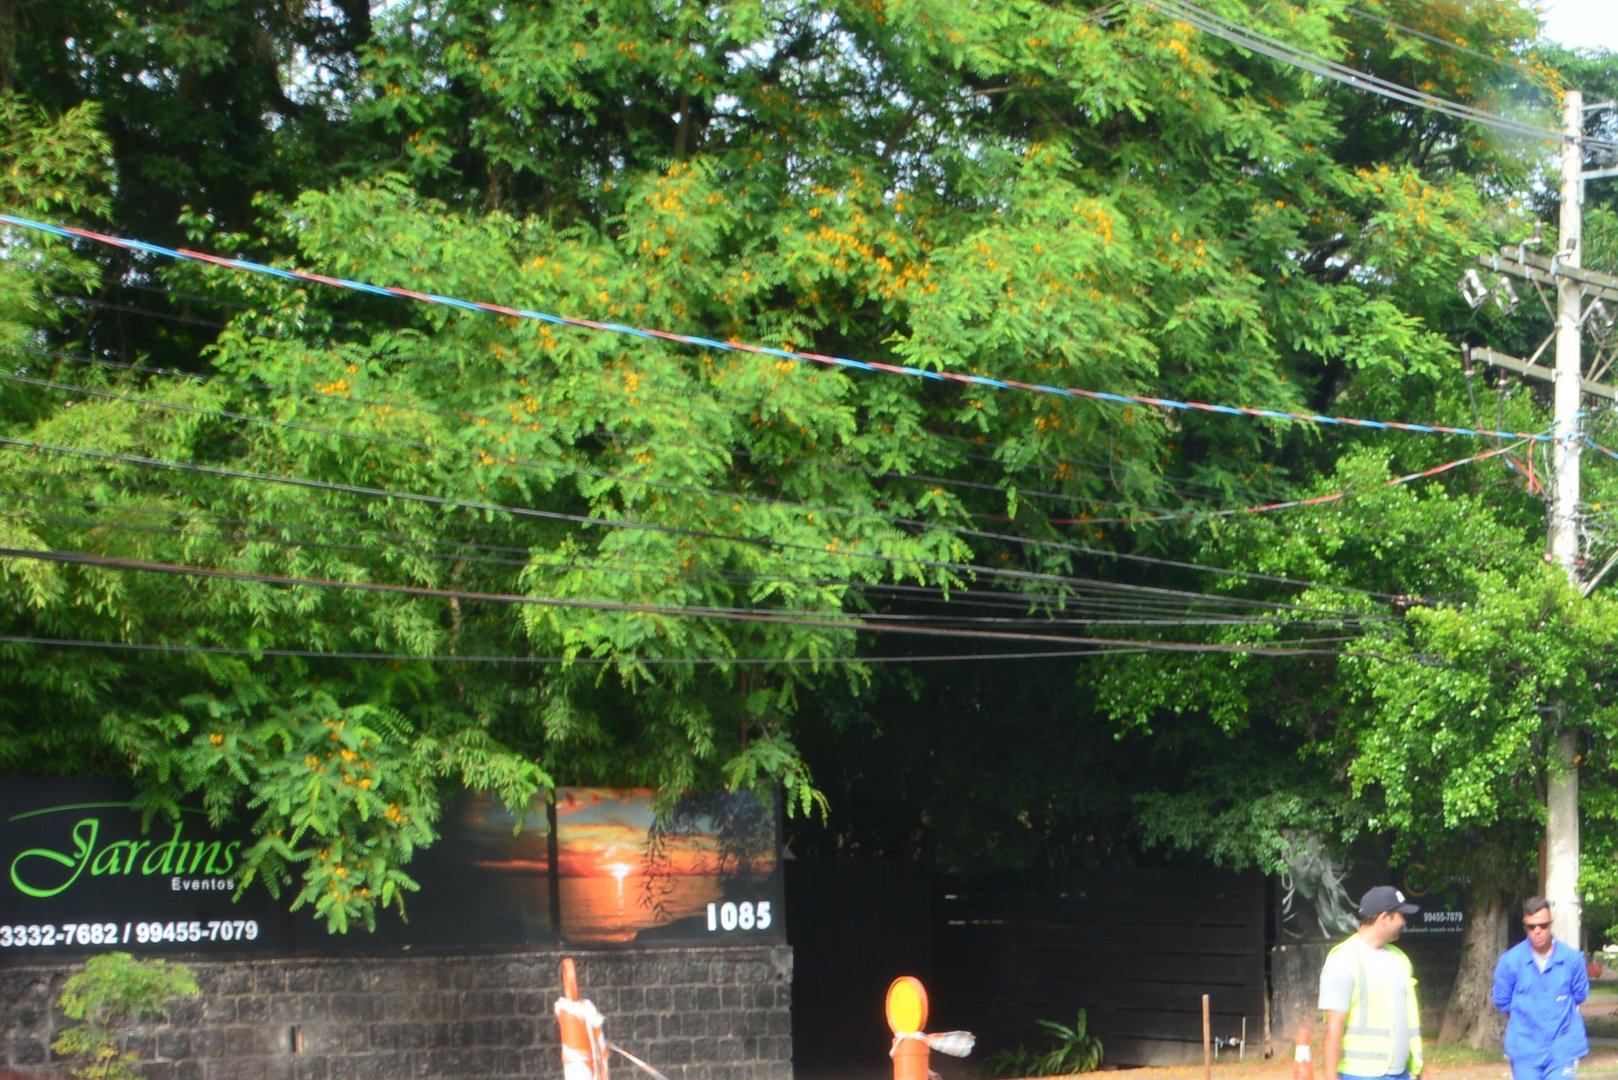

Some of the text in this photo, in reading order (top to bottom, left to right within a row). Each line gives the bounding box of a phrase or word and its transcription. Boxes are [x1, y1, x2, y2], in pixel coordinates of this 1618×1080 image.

[11, 817, 242, 898] Jardins
[171, 876, 235, 891] Eventos
[706, 901, 772, 931] 1085
[1423, 911, 1463, 923] 99455-7079
[0, 920, 259, 947] 3332-7682 / 99455-7079
